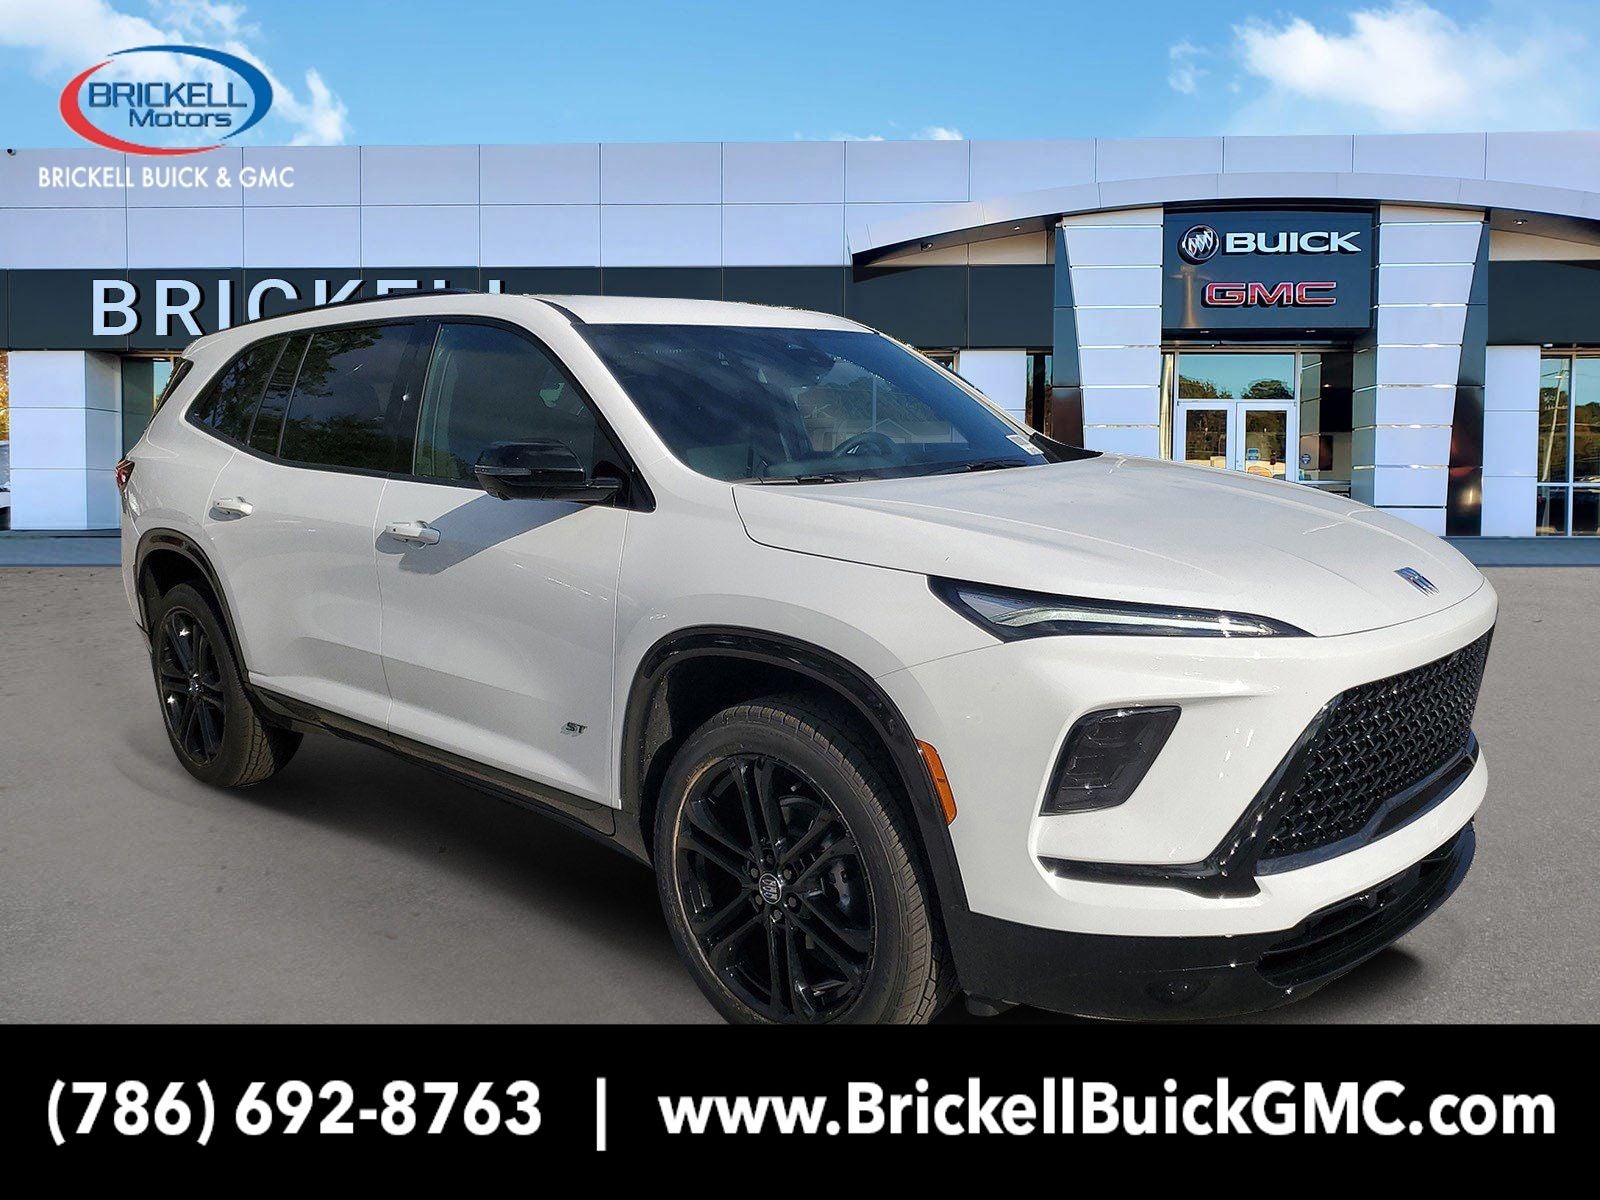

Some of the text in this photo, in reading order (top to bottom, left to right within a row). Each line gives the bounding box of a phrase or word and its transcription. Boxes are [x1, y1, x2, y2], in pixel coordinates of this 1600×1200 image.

[1225, 231, 1362, 253] BUICK
[1205, 281, 1337, 306] GMC
[565, 721, 588, 734] ST
